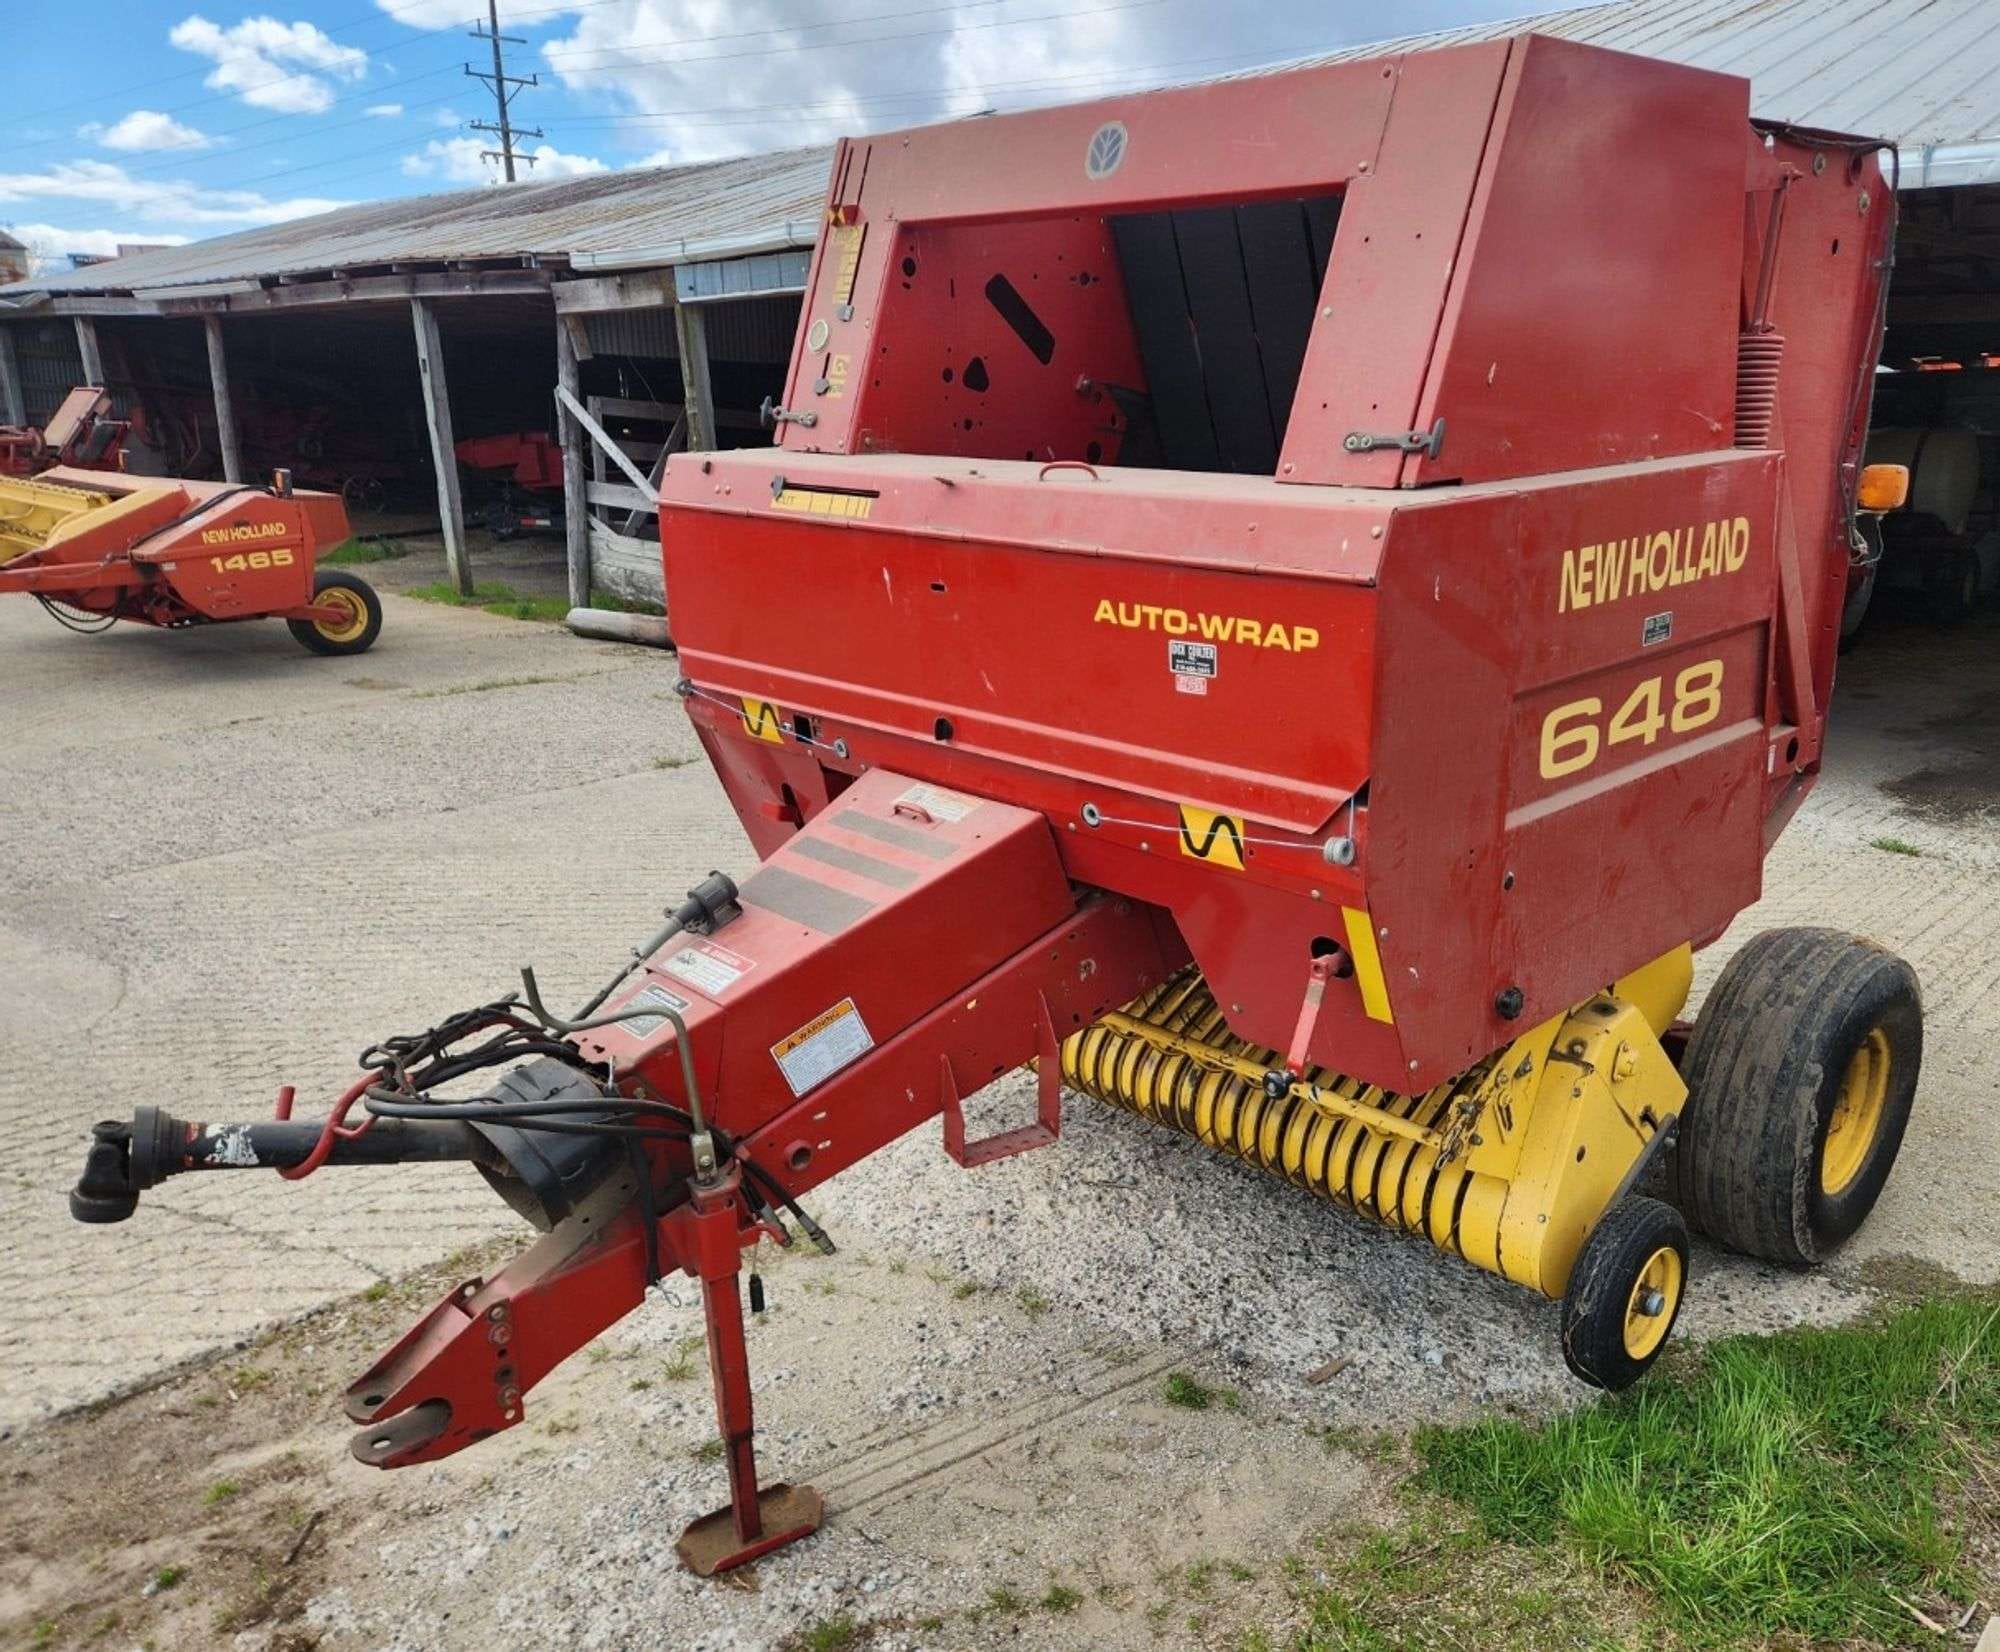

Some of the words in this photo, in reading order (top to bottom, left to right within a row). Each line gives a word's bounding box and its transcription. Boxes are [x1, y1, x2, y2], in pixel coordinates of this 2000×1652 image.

[202, 529, 229, 544] NEW
[230, 522, 286, 541] HOLLAND
[210, 549, 294, 573] 1465
[1558, 539, 1627, 613] NEW
[1627, 517, 1749, 597] HOLLAND
[1094, 600, 1319, 652] AUTO-WRAP
[1540, 659, 1724, 778] 648
[799, 1011, 840, 1040] WARNING
